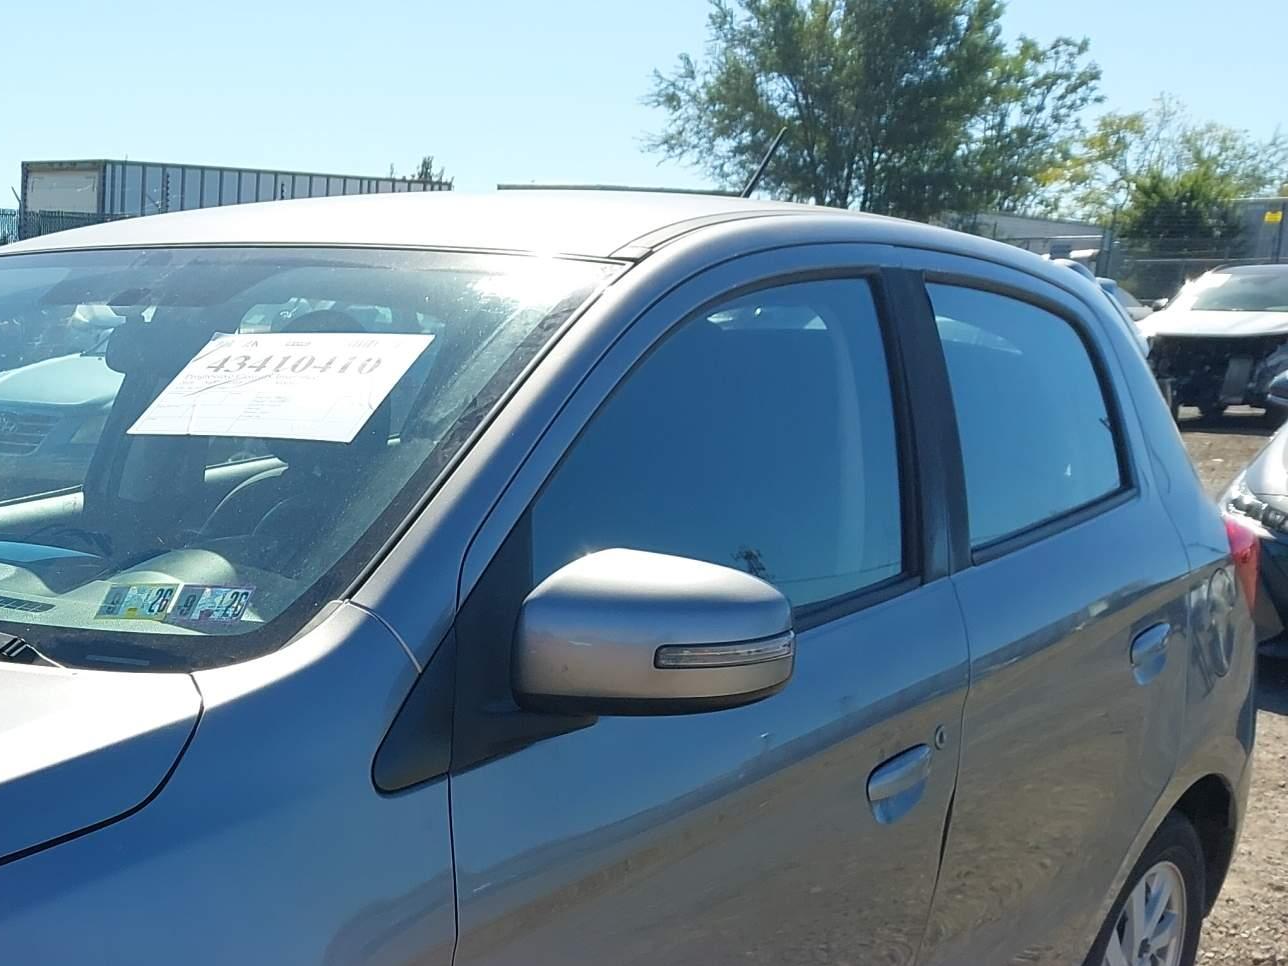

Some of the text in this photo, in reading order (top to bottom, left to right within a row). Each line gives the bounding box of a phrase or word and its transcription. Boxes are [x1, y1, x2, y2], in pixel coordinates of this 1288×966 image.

[207, 355, 383, 375] 43410410
[149, 587, 174, 613] 26
[179, 591, 249, 619] 9 26
